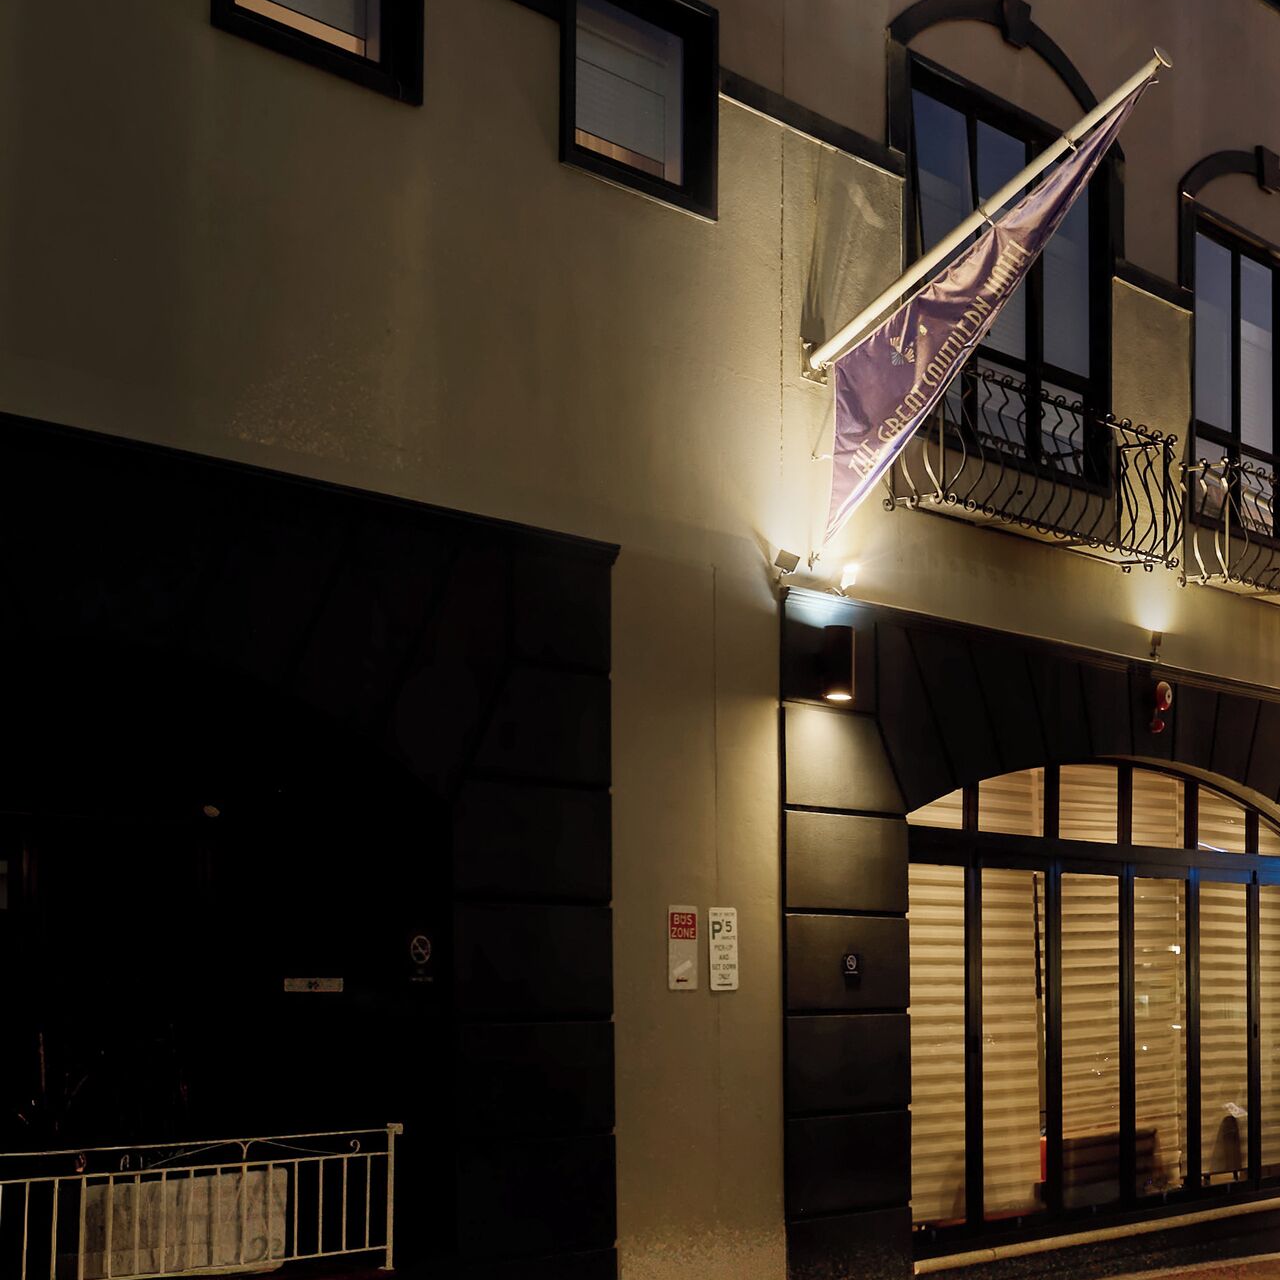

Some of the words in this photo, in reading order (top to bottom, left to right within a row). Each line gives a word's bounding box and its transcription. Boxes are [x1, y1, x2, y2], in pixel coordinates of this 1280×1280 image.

[878, 383, 927, 443] GREAT
[673, 914, 693, 925] BUS
[671, 927, 695, 939] ZONE
[711, 920, 723, 940] P
[725, 920, 733, 933] 5
